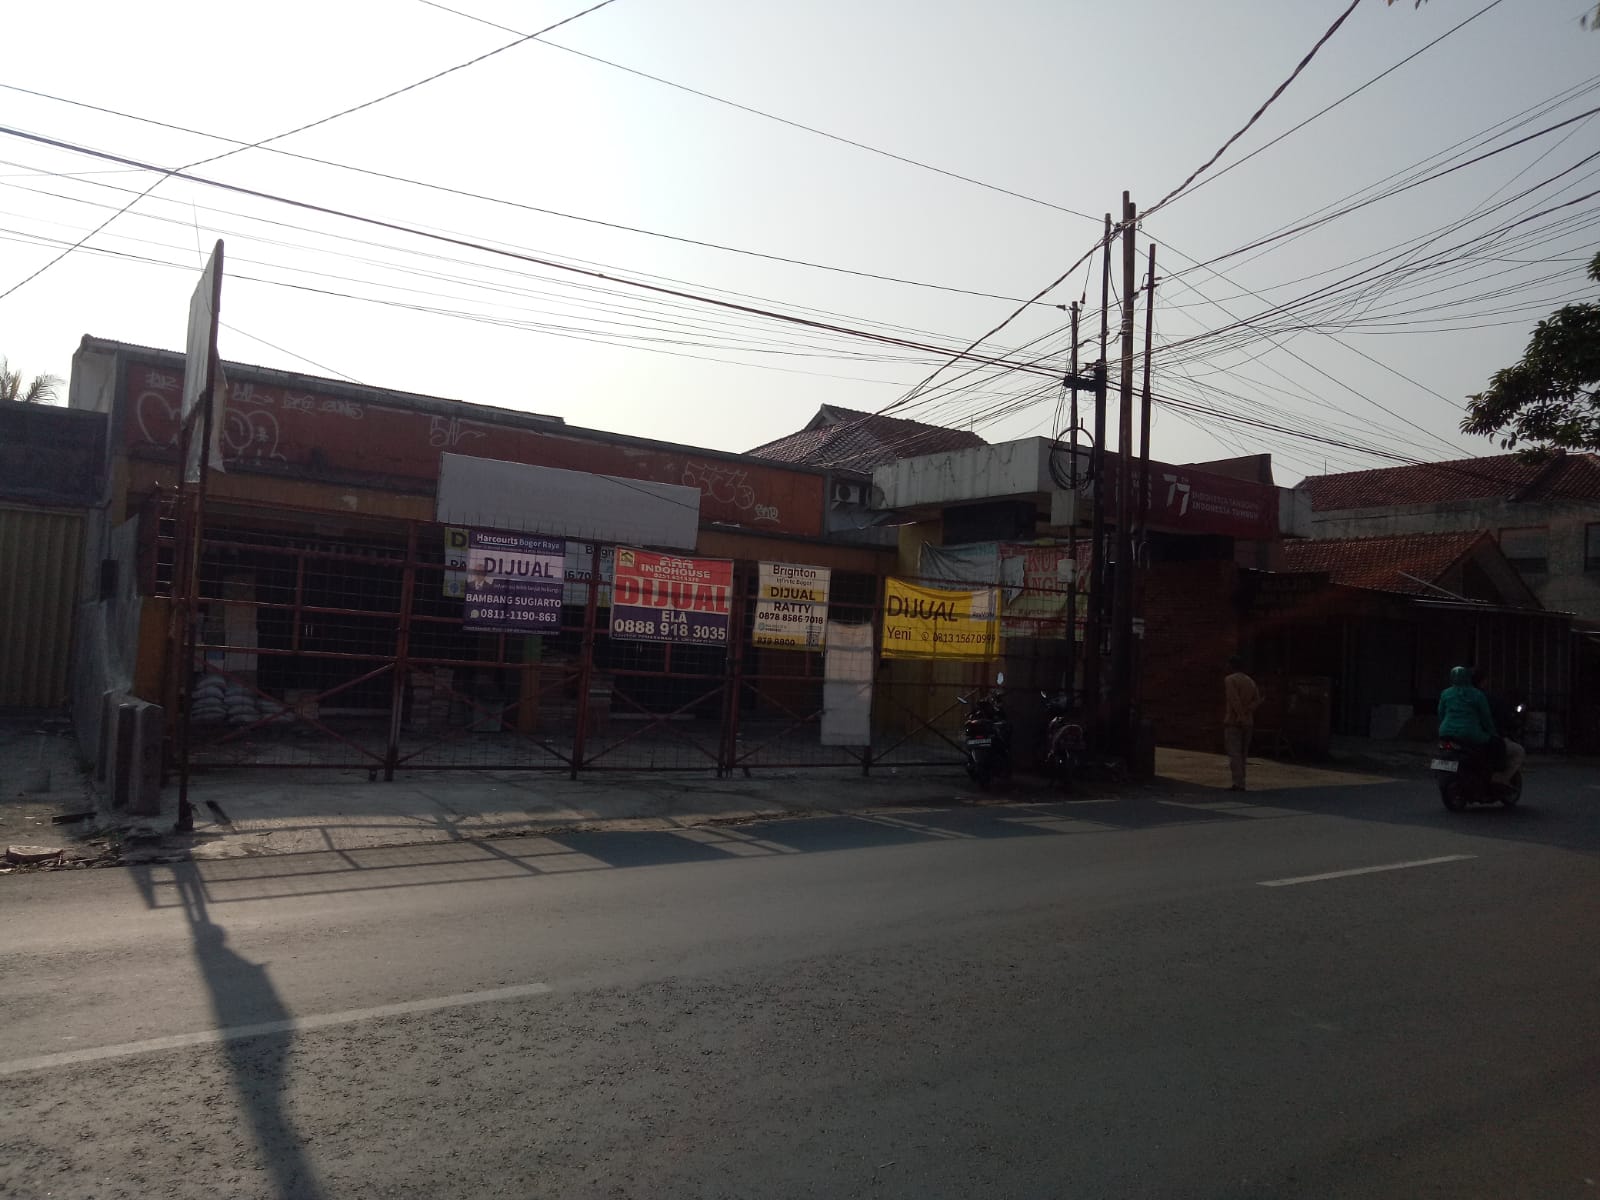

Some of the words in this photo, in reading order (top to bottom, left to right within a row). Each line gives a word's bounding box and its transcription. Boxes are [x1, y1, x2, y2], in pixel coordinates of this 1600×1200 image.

[477, 533, 518, 545] Harcourts
[519, 538, 541, 548] Bogor
[543, 540, 559, 550] Raya
[485, 557, 554, 578] DIJUAL
[641, 564, 711, 578] INDOHOUSE
[773, 564, 816, 578] Brighton
[466, 593, 513, 605] BAMBANG
[515, 595, 562, 608] SUGIARTO
[615, 576, 729, 613] DIJUAL
[771, 586, 816, 600] DIJUAL
[480, 608, 557, 622] 0811-1190-863
[774, 602, 811, 613] RATTY
[887, 595, 958, 622] DIJUAL
[661, 610, 688, 623] ELA
[614, 618, 655, 635] 0888
[660, 622, 688, 637] 918
[693, 625, 726, 640] 3035
[886, 626, 911, 641] Yeni
